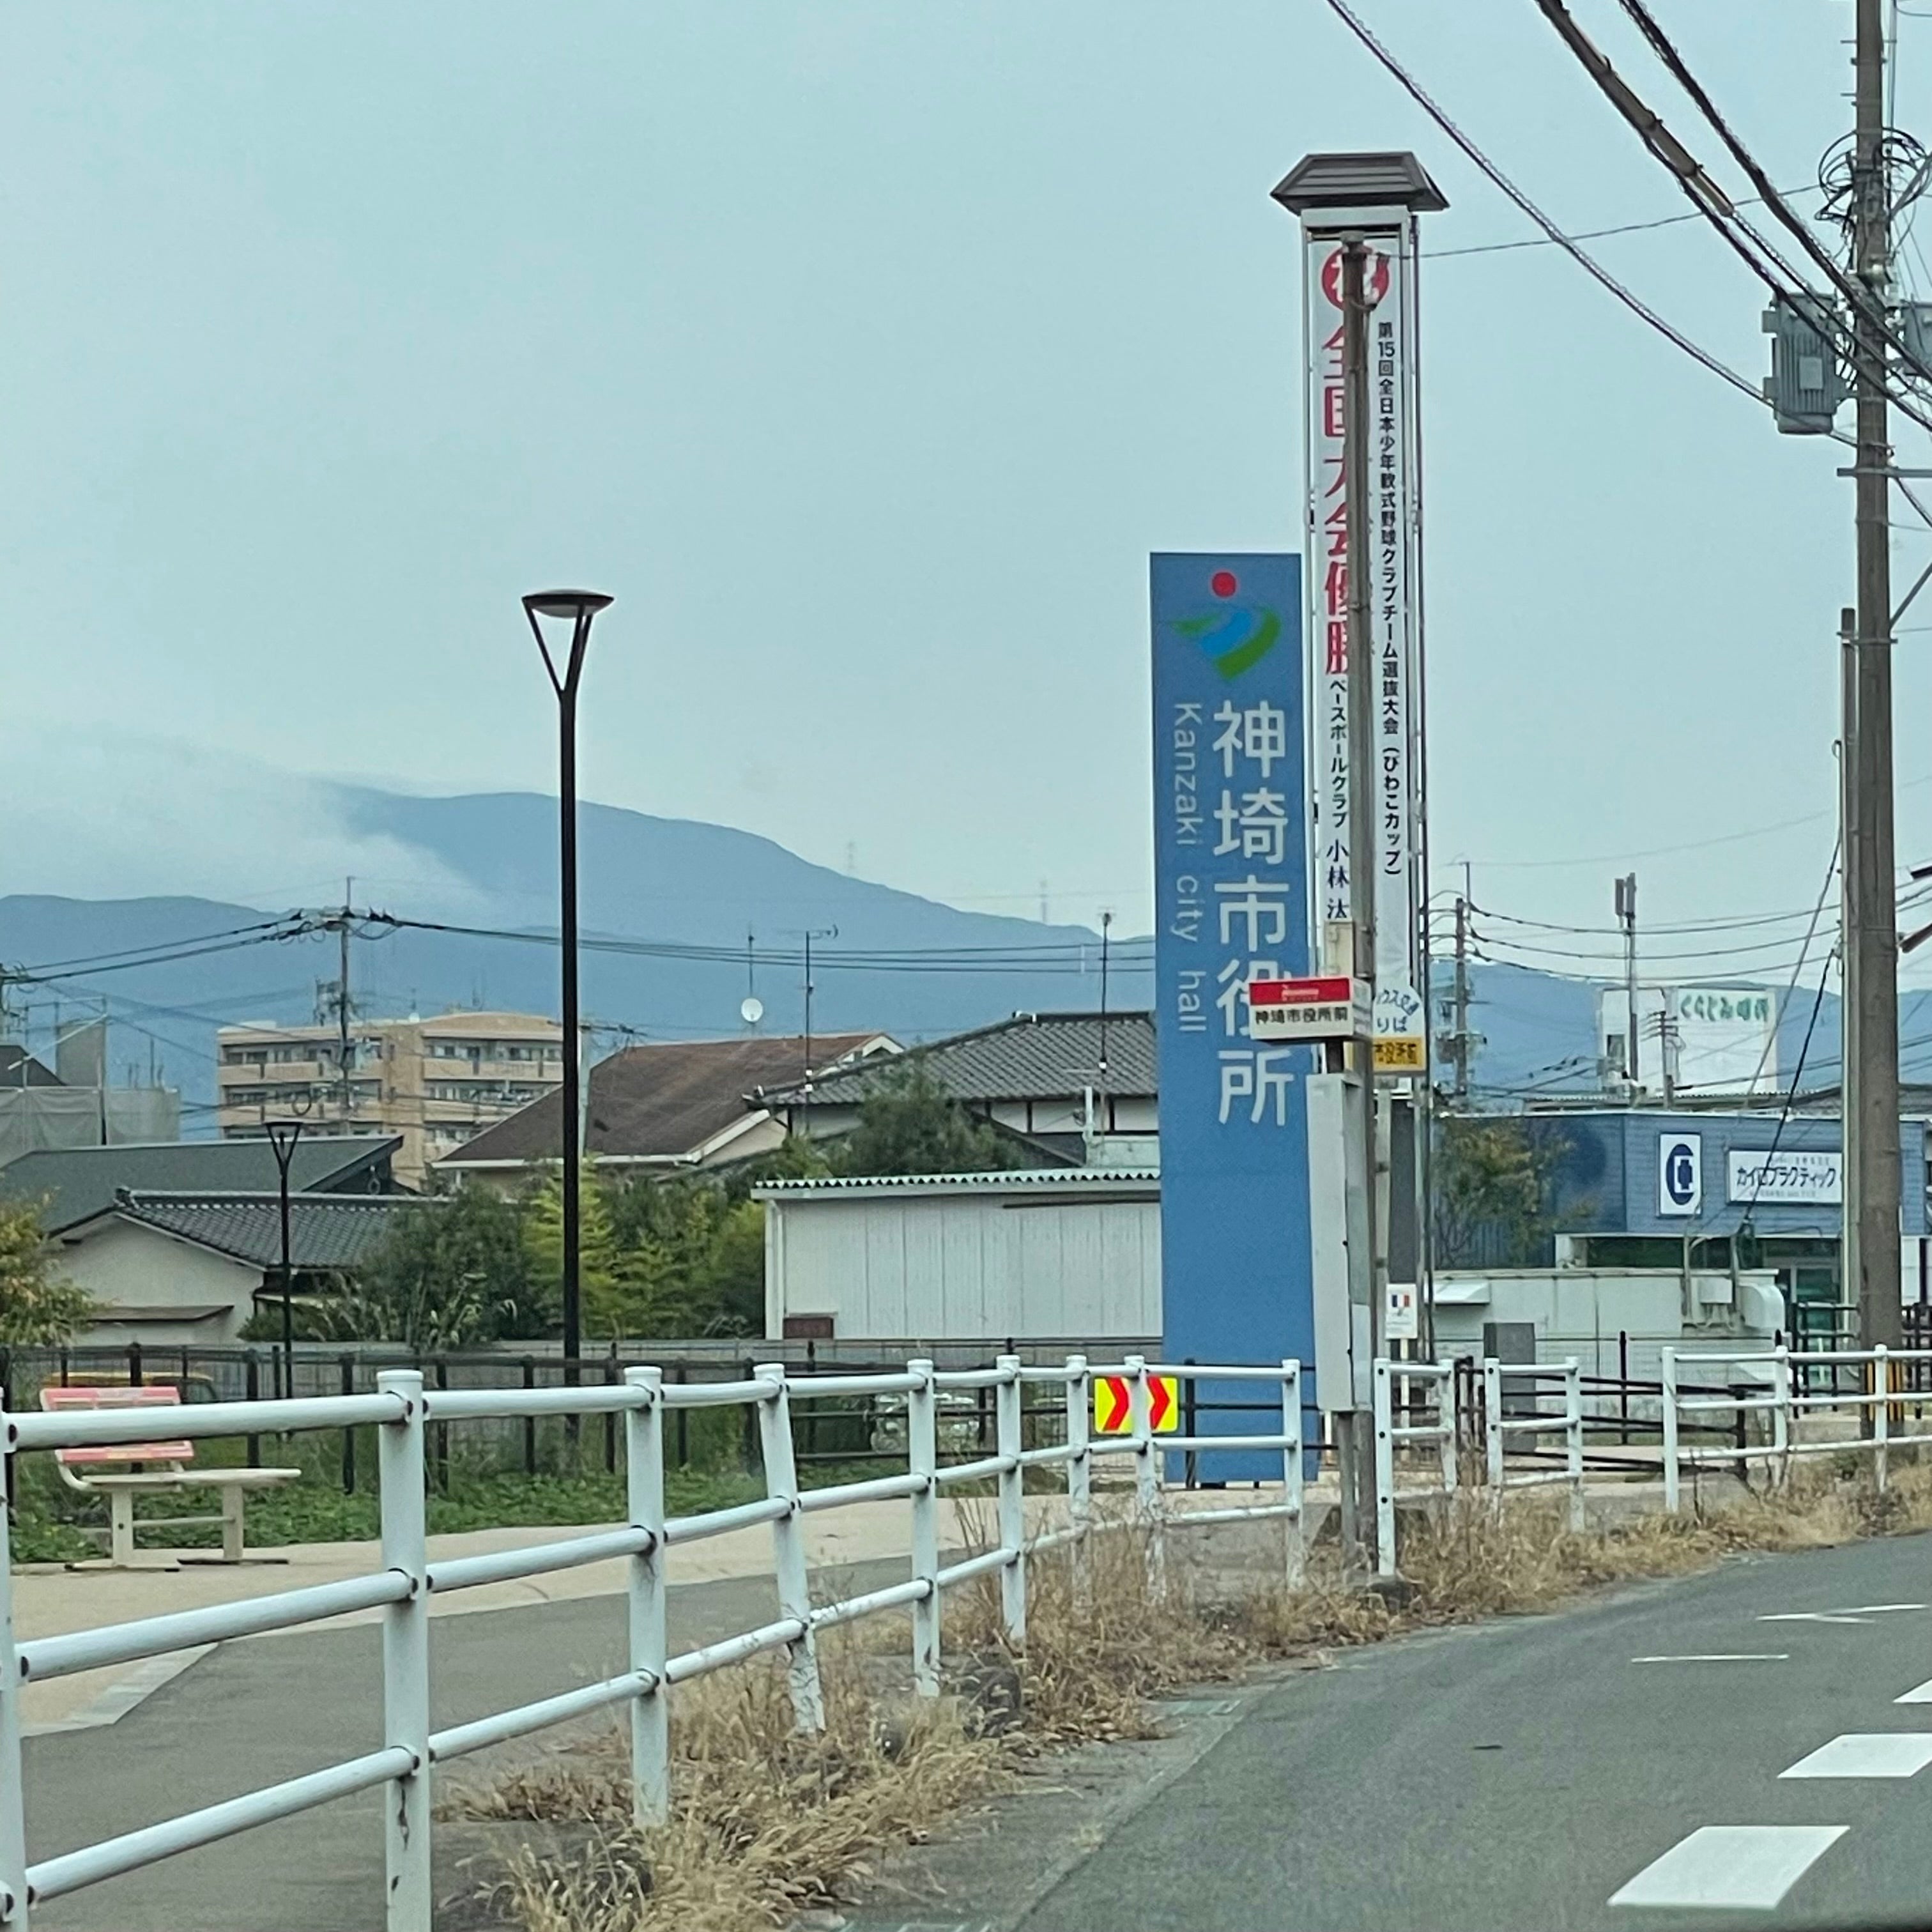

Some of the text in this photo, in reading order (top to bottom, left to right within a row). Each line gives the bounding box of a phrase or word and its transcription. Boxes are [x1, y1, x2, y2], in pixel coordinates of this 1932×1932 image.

[1170, 703, 1207, 1031] Kanzaki city hall
